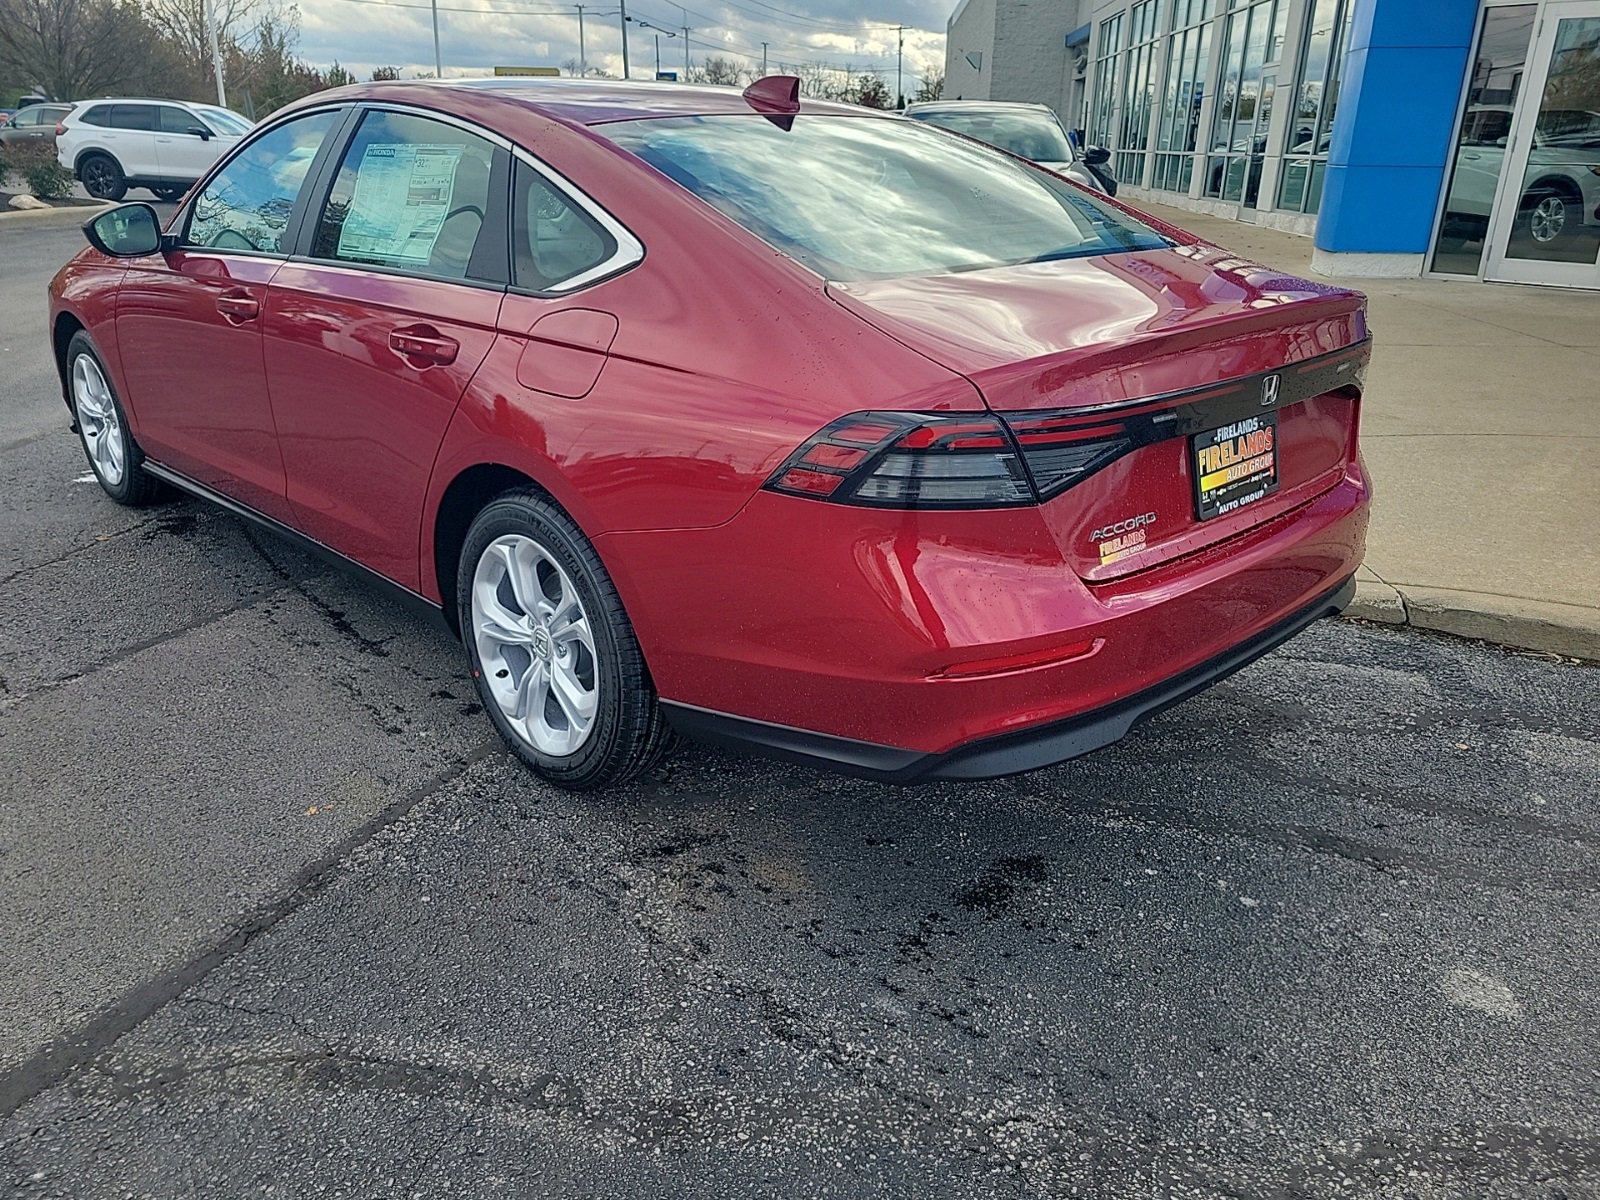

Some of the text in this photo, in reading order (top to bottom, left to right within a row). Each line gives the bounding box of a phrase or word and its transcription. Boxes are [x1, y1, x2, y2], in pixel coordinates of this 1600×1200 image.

[1217, 417, 1258, 442] FIRELANDS
[1198, 426, 1273, 476] FIRELANDS
[1226, 454, 1274, 482] AUTO GROUP
[1218, 489, 1265, 515] AUTO GROUP
[1089, 511, 1157, 542] ACCORD
[538, 524, 580, 572] MICHELIN
[1099, 529, 1146, 557] FIRELANDS
